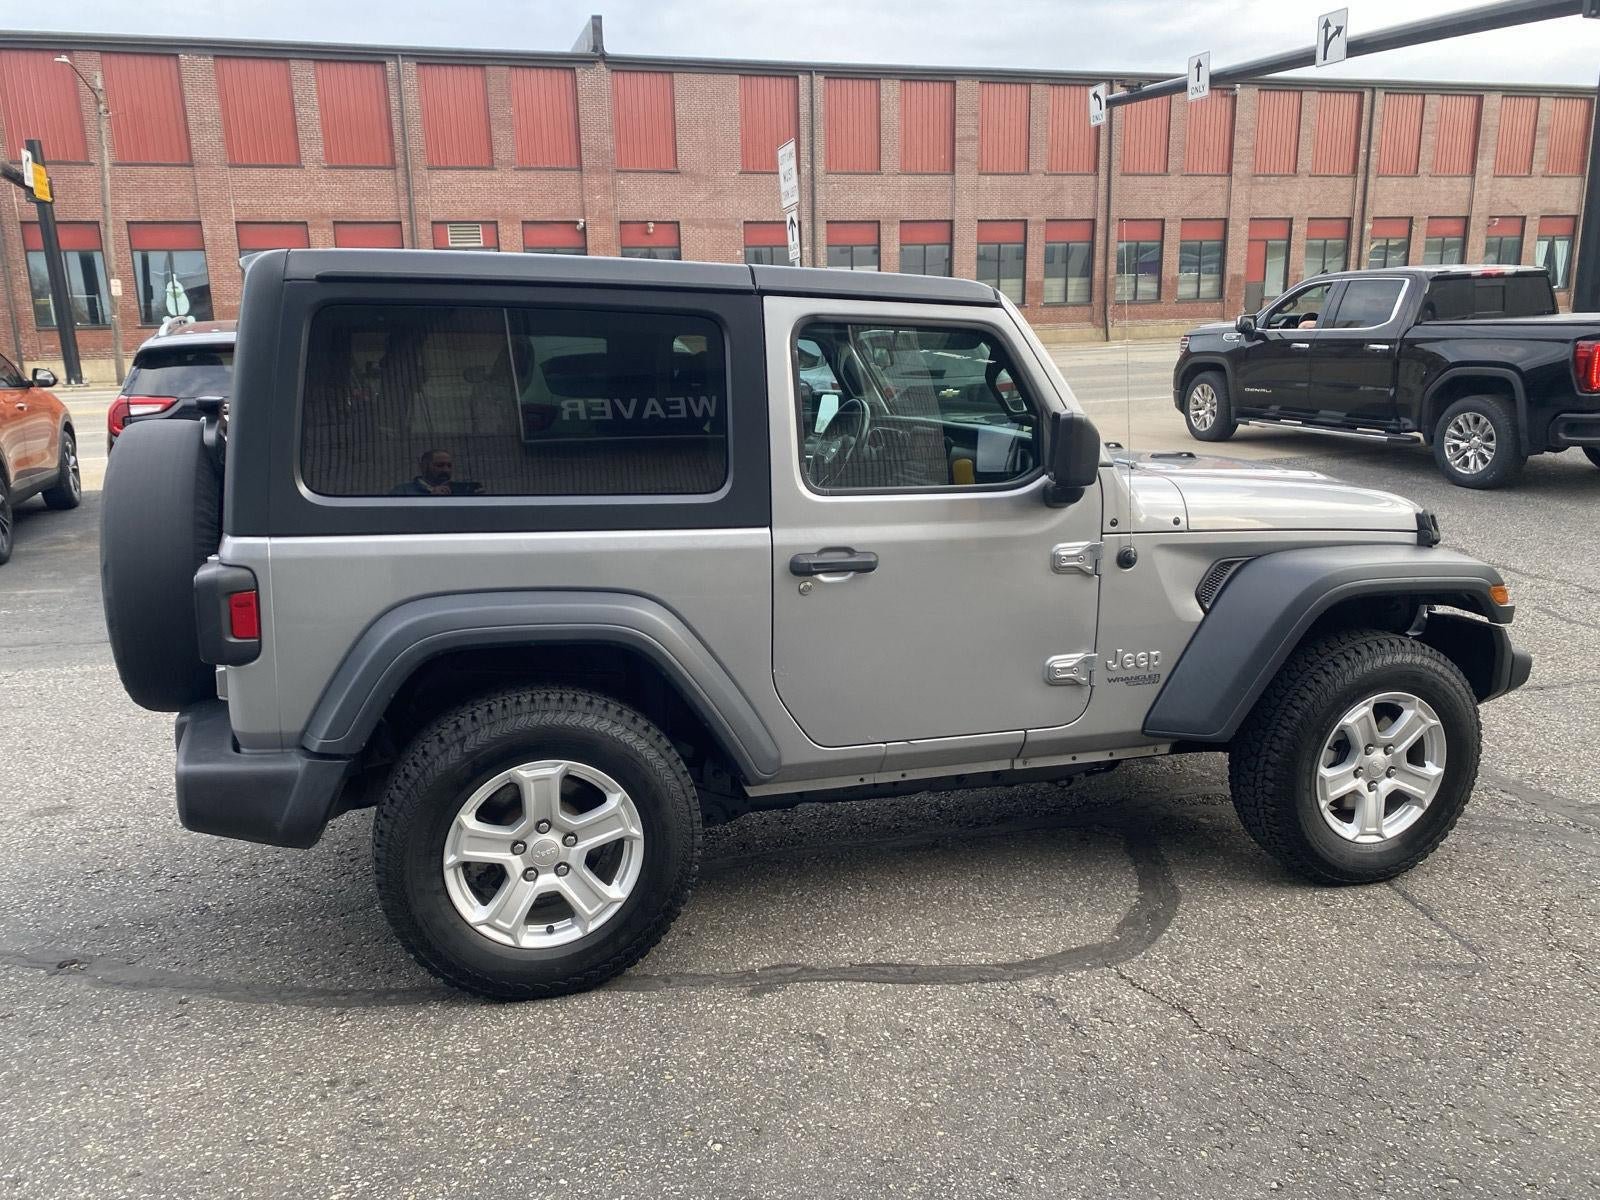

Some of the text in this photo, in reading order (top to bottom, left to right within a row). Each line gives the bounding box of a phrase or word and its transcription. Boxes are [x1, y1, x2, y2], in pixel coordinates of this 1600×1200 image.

[1190, 84, 1206, 96] ONLY
[1105, 648, 1161, 672] Jeep
[1107, 673, 1161, 684] WRANGLER
